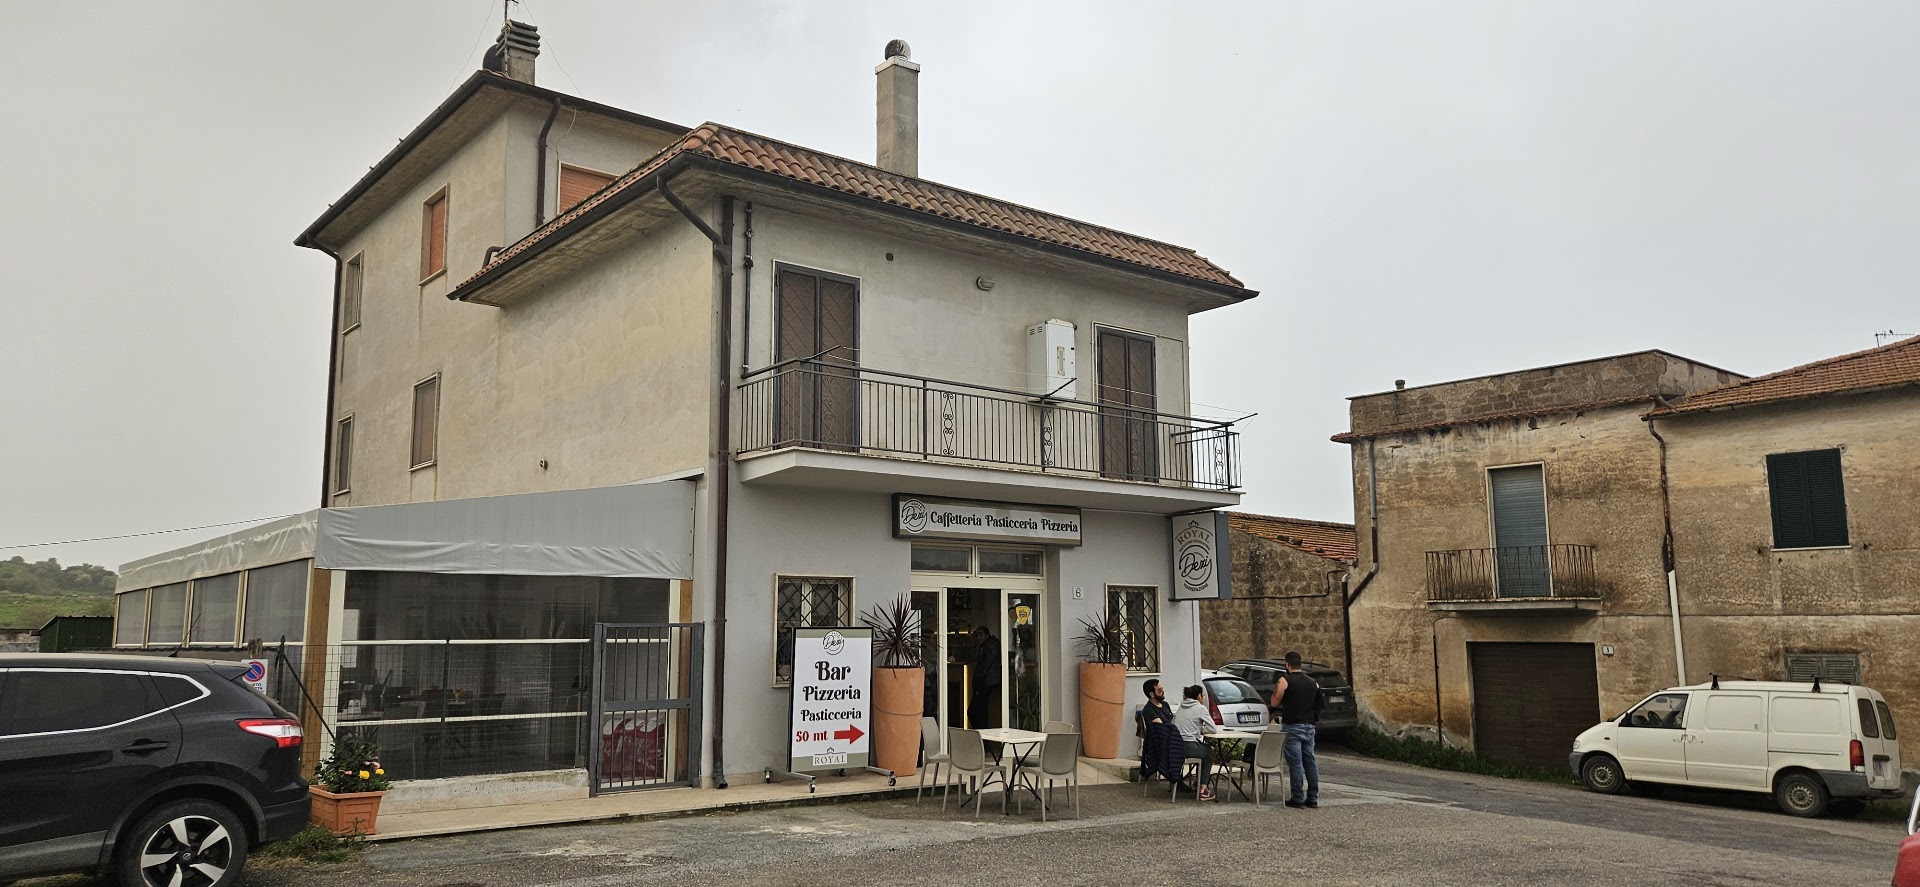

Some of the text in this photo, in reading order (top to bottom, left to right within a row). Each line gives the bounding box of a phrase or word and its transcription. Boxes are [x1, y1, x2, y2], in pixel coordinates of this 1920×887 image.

[930, 511, 982, 527] Caffetteria
[984, 514, 1038, 530] Pasticceria
[1041, 517, 1078, 533] Pizzeria
[1177, 529, 1211, 545] ROYAL
[1075, 587, 1082, 598] 6
[814, 660, 851, 681] Bar
[802, 685, 861, 701] Pizzeria
[800, 708, 862, 721] Pasticceria
[796, 730, 828, 742] 50 mt
[814, 755, 846, 765] ROYAL
